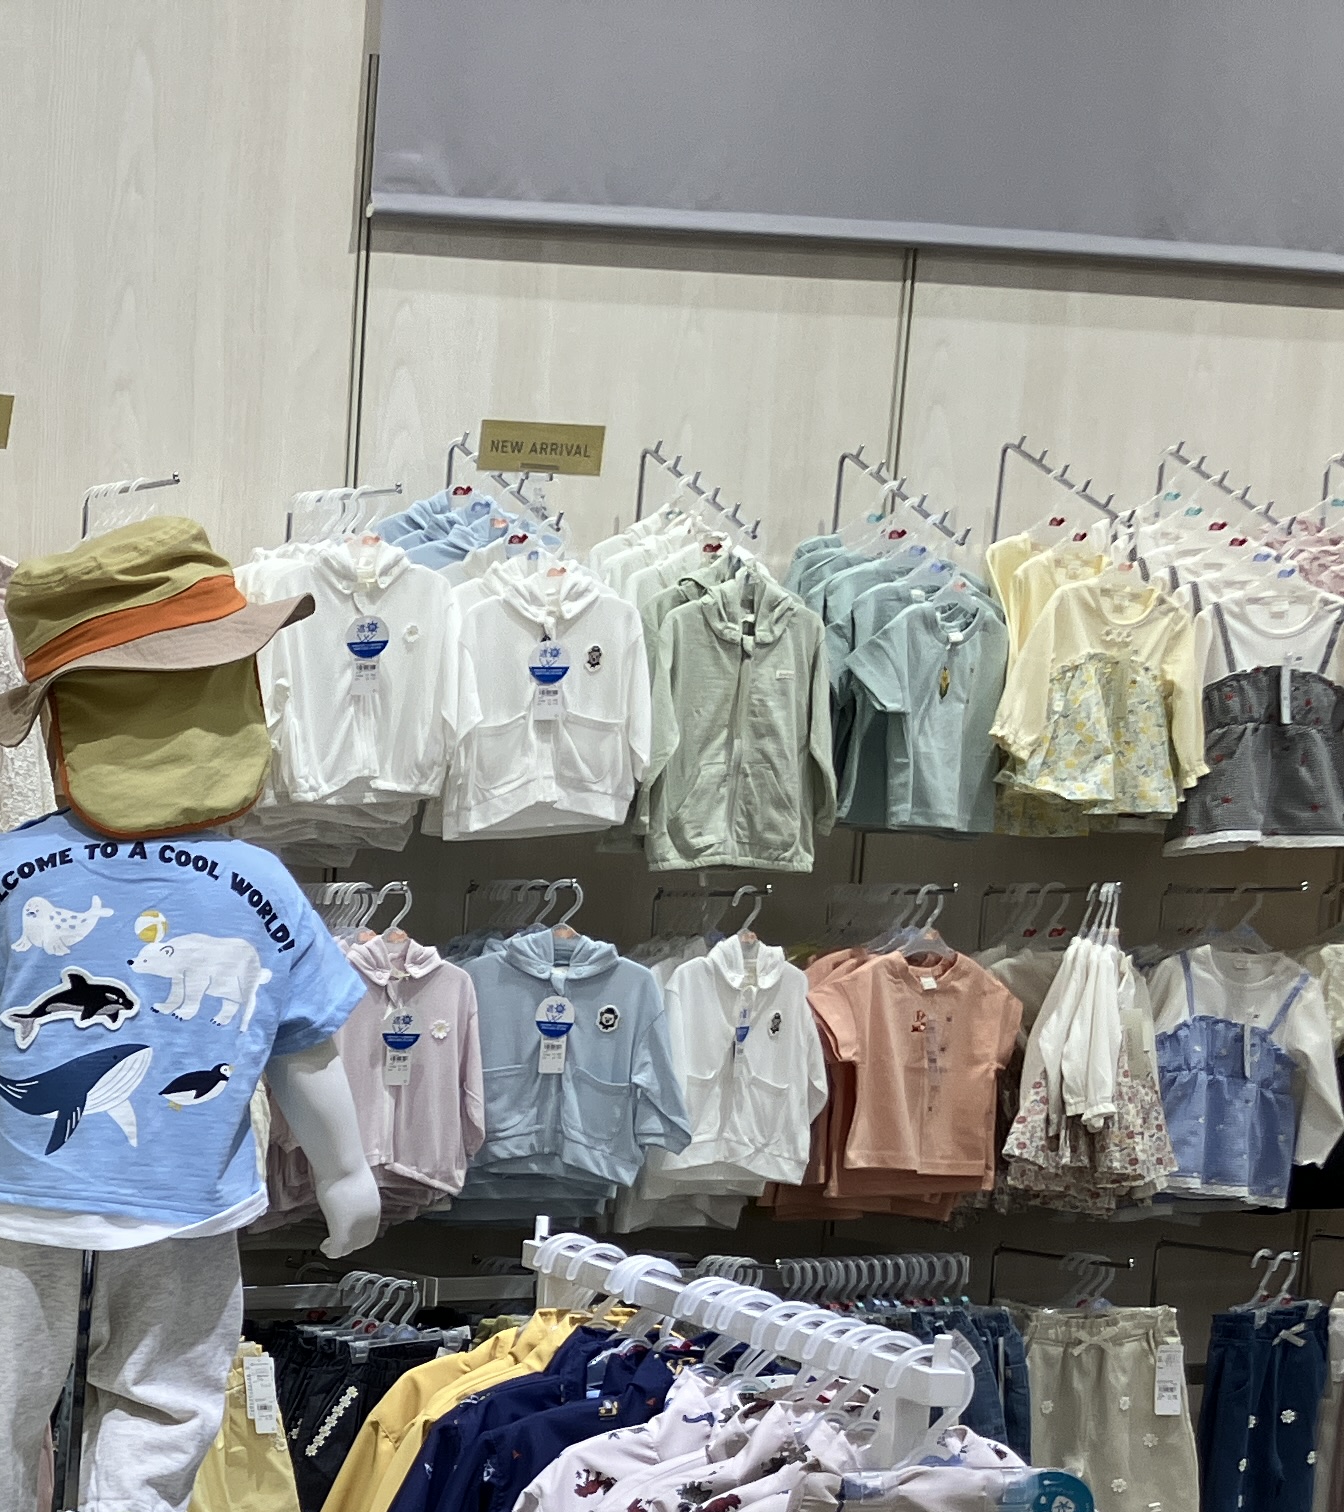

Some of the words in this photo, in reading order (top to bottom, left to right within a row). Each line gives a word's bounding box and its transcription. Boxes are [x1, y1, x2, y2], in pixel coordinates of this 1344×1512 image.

[490, 440, 524, 454] NEW
[529, 442, 590, 457] ARRIVAL
[84, 841, 119, 861] TO
[128, 841, 148, 860] A
[159, 843, 221, 880] COOL
[230, 871, 296, 953] WORLD!
